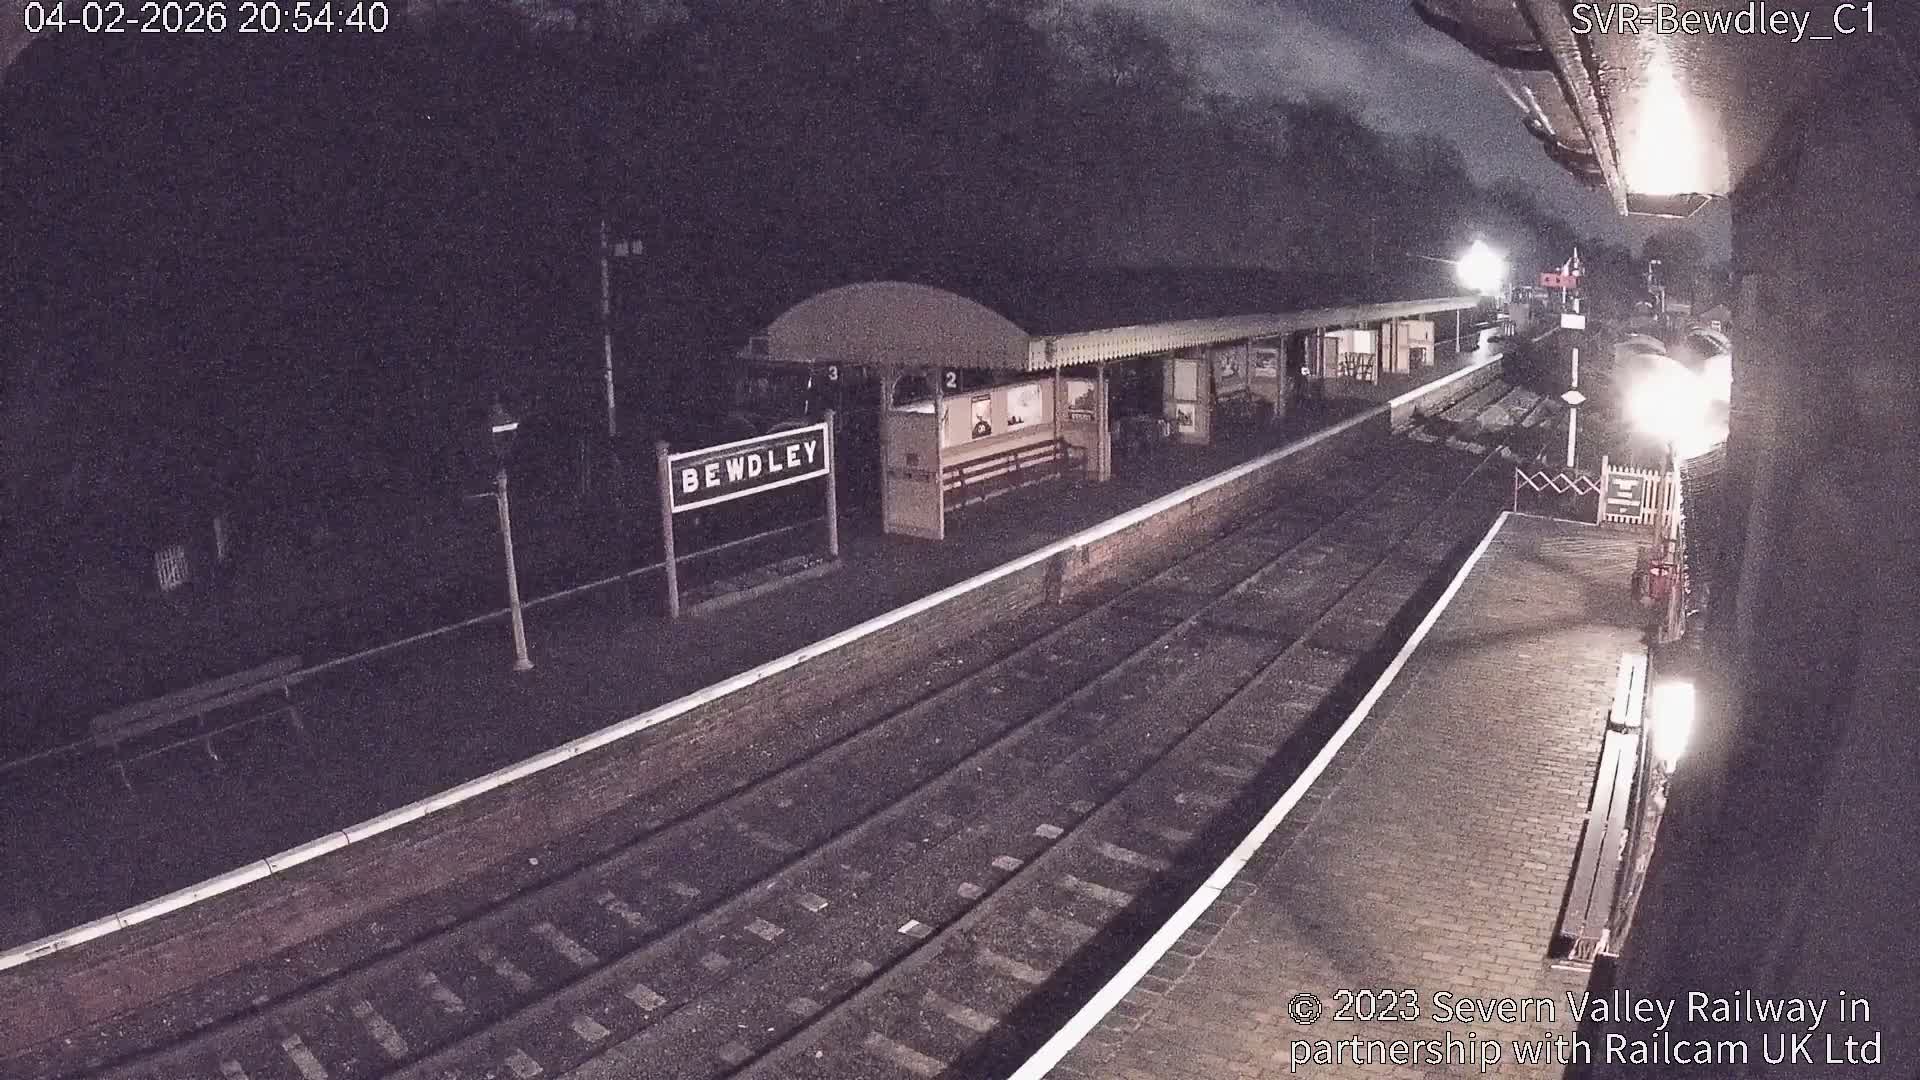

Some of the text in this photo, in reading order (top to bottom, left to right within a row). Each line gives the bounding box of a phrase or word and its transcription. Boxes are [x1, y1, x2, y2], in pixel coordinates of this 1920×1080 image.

[828, 366, 838, 381] 3
[946, 371, 957, 388] 2
[682, 440, 817, 493] BEWDLEY
